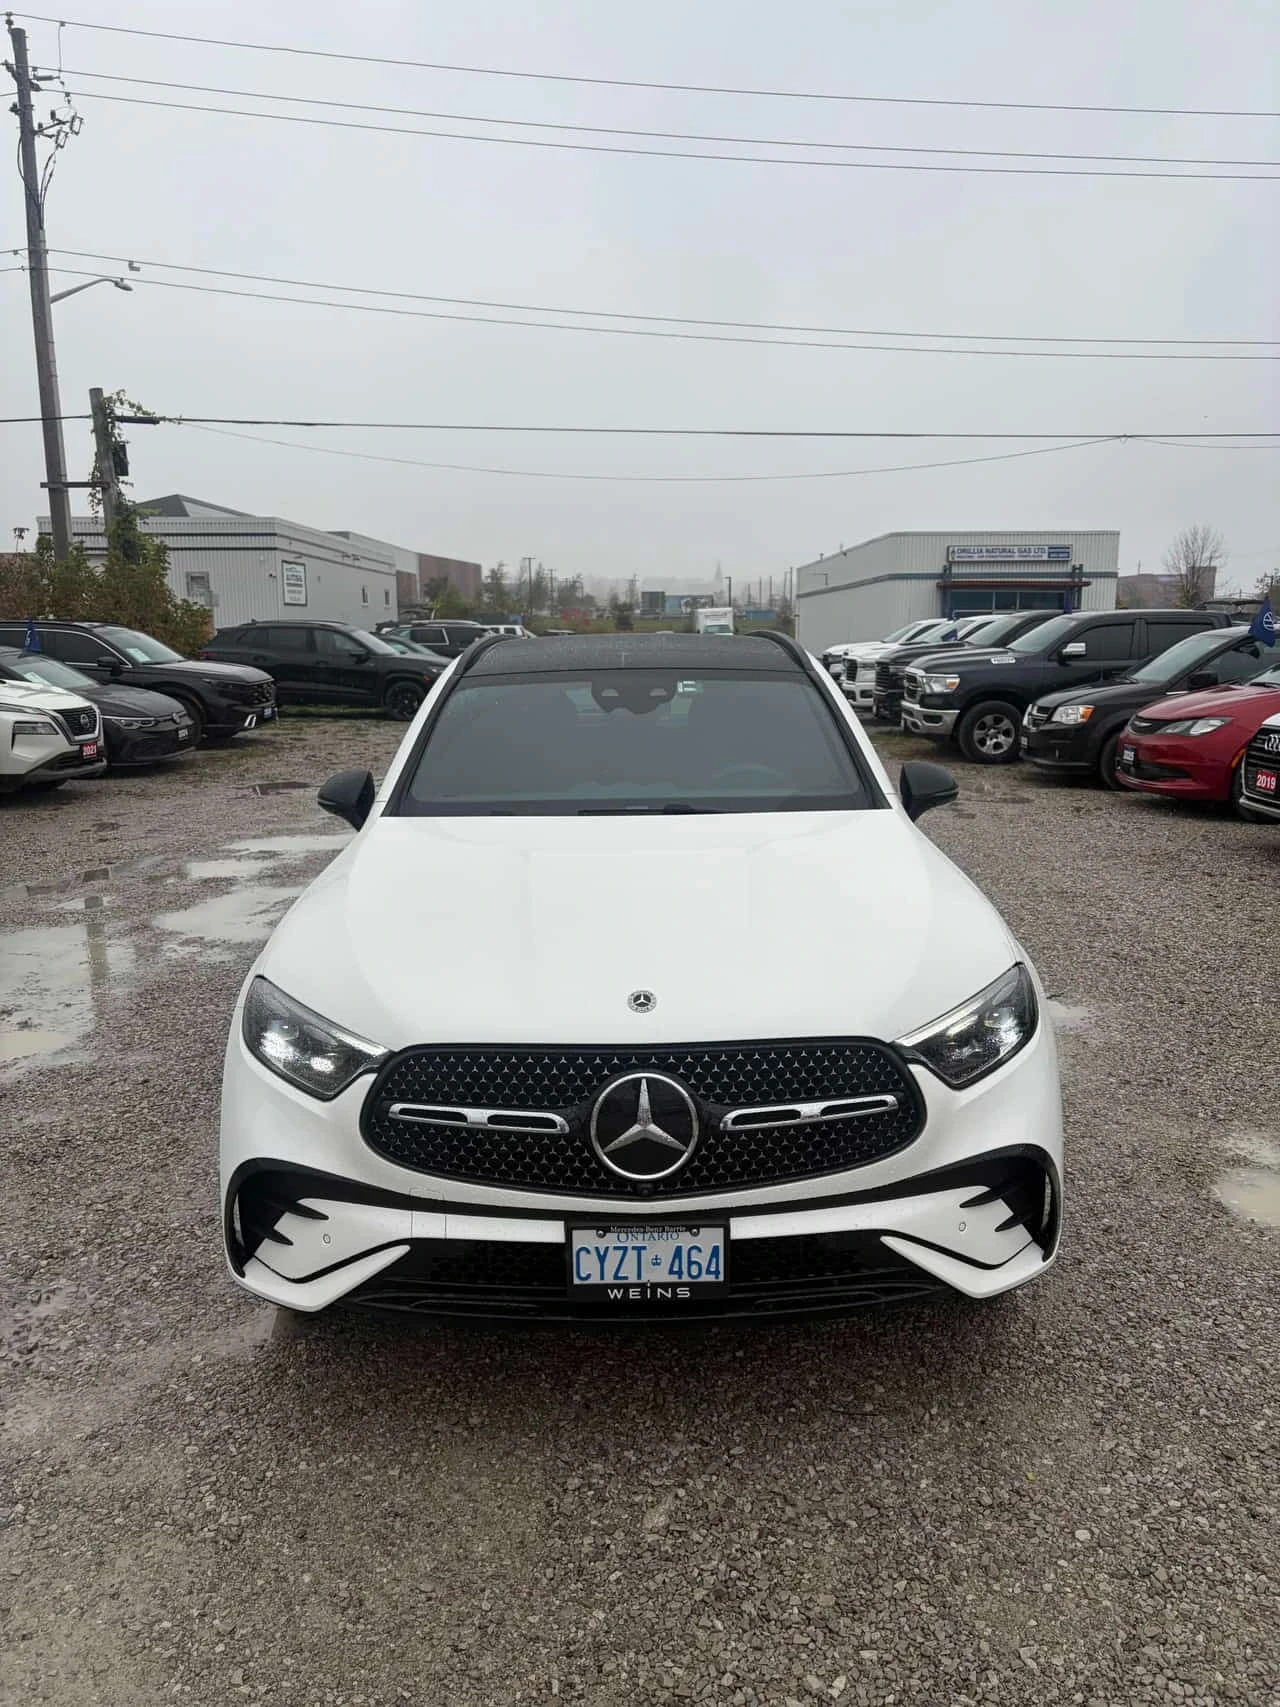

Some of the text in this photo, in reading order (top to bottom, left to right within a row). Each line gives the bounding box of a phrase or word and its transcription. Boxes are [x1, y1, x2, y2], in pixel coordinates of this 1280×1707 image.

[83, 744, 97, 756] 2021
[1256, 774, 1277, 790] 2019
[616, 1231, 680, 1243] ONTARIO
[575, 1245, 721, 1281] CYZT 464
